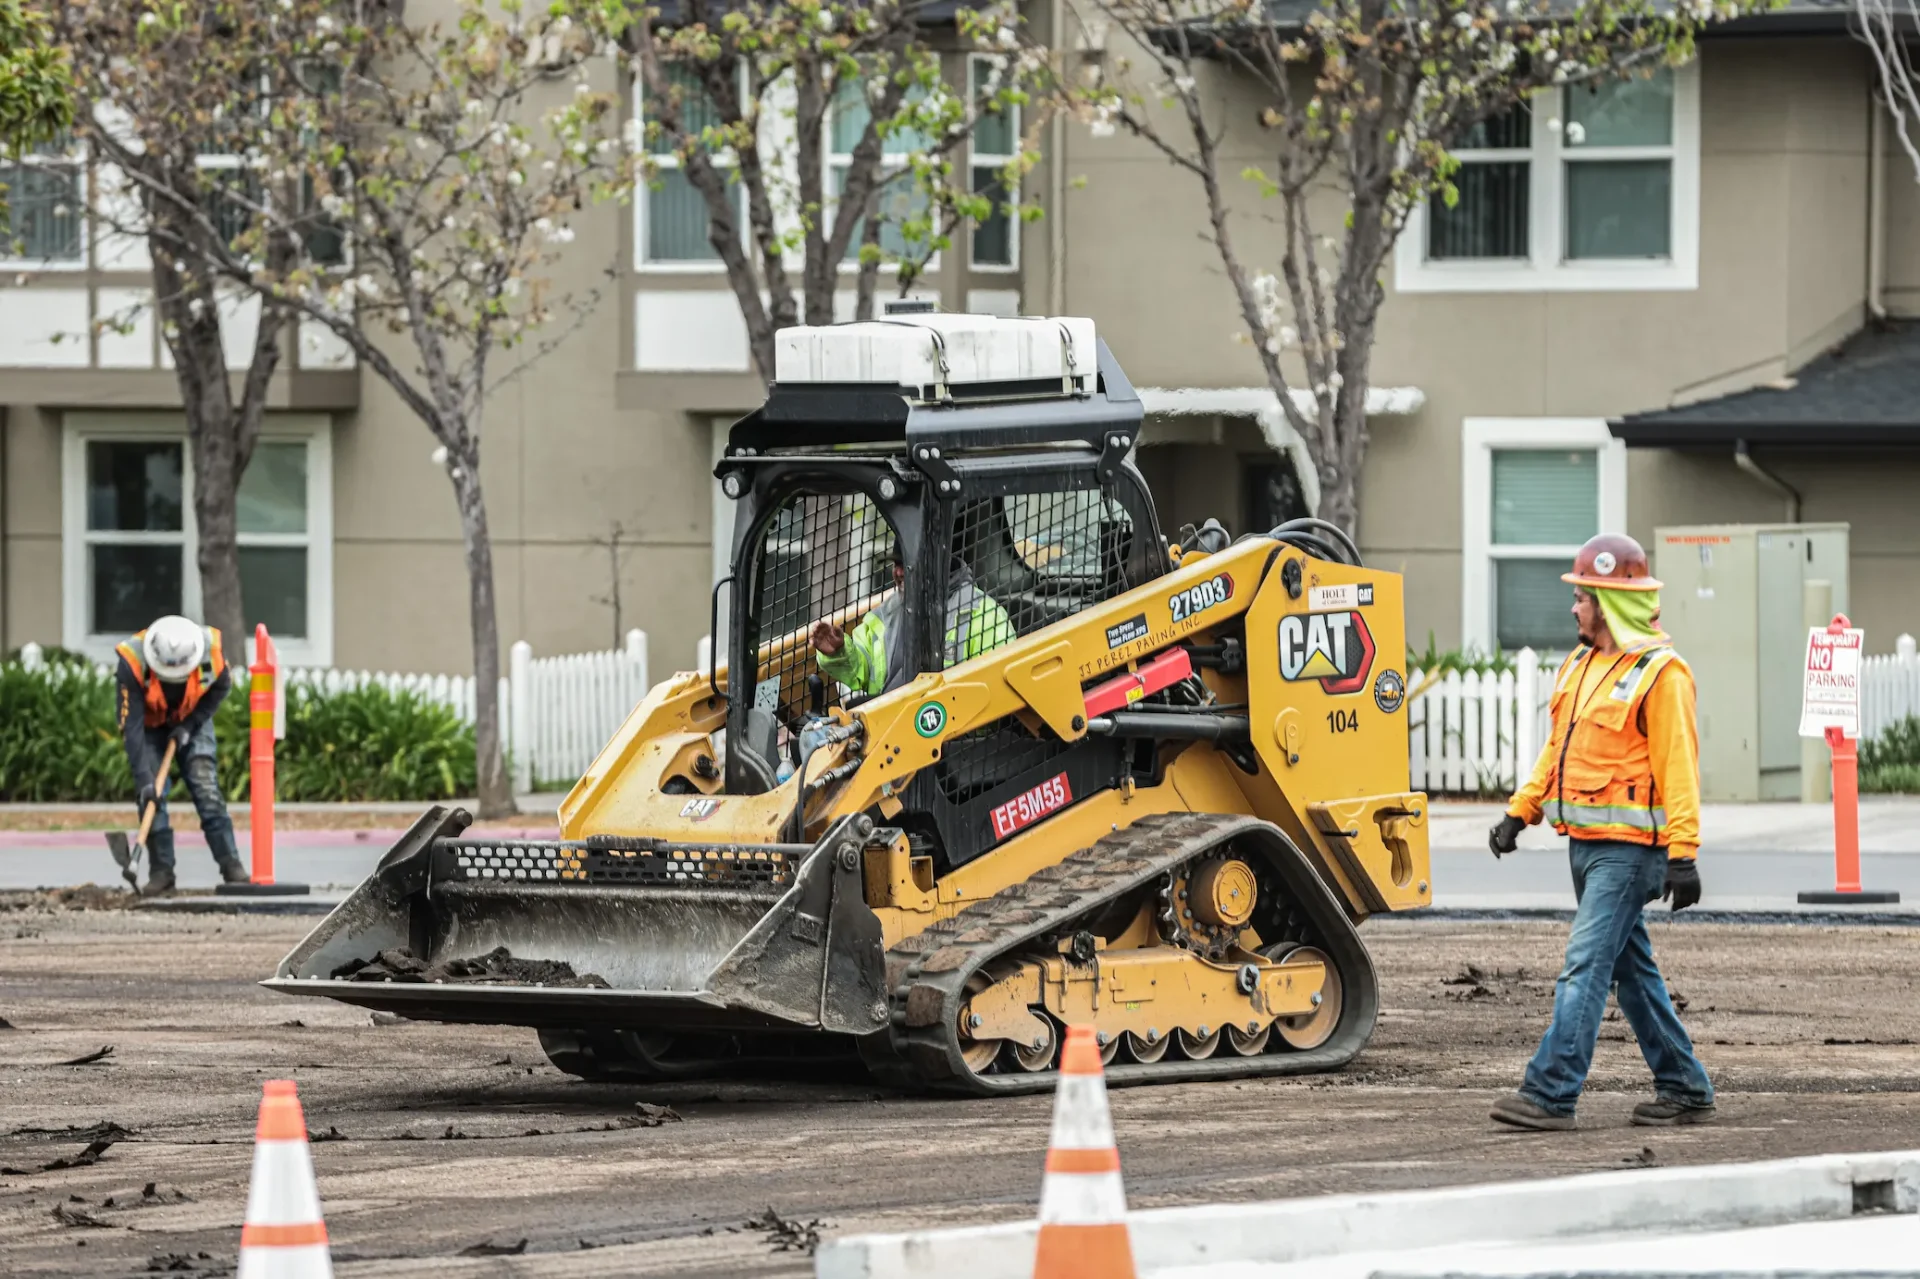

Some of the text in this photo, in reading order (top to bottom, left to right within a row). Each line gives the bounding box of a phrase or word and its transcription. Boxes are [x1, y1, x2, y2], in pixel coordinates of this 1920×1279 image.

[1169, 576, 1226, 623] 279D3
[1322, 588, 1347, 599] HOLT
[1358, 588, 1373, 602] CAT
[1078, 615, 1203, 677] JJ PEREZ PAVING INC.
[1279, 612, 1351, 679] CAT
[1810, 646, 1831, 670] NO
[1808, 672, 1856, 688] PARKING
[922, 709, 938, 730] T4
[1326, 708, 1359, 734] 104
[679, 799, 718, 817] CAT
